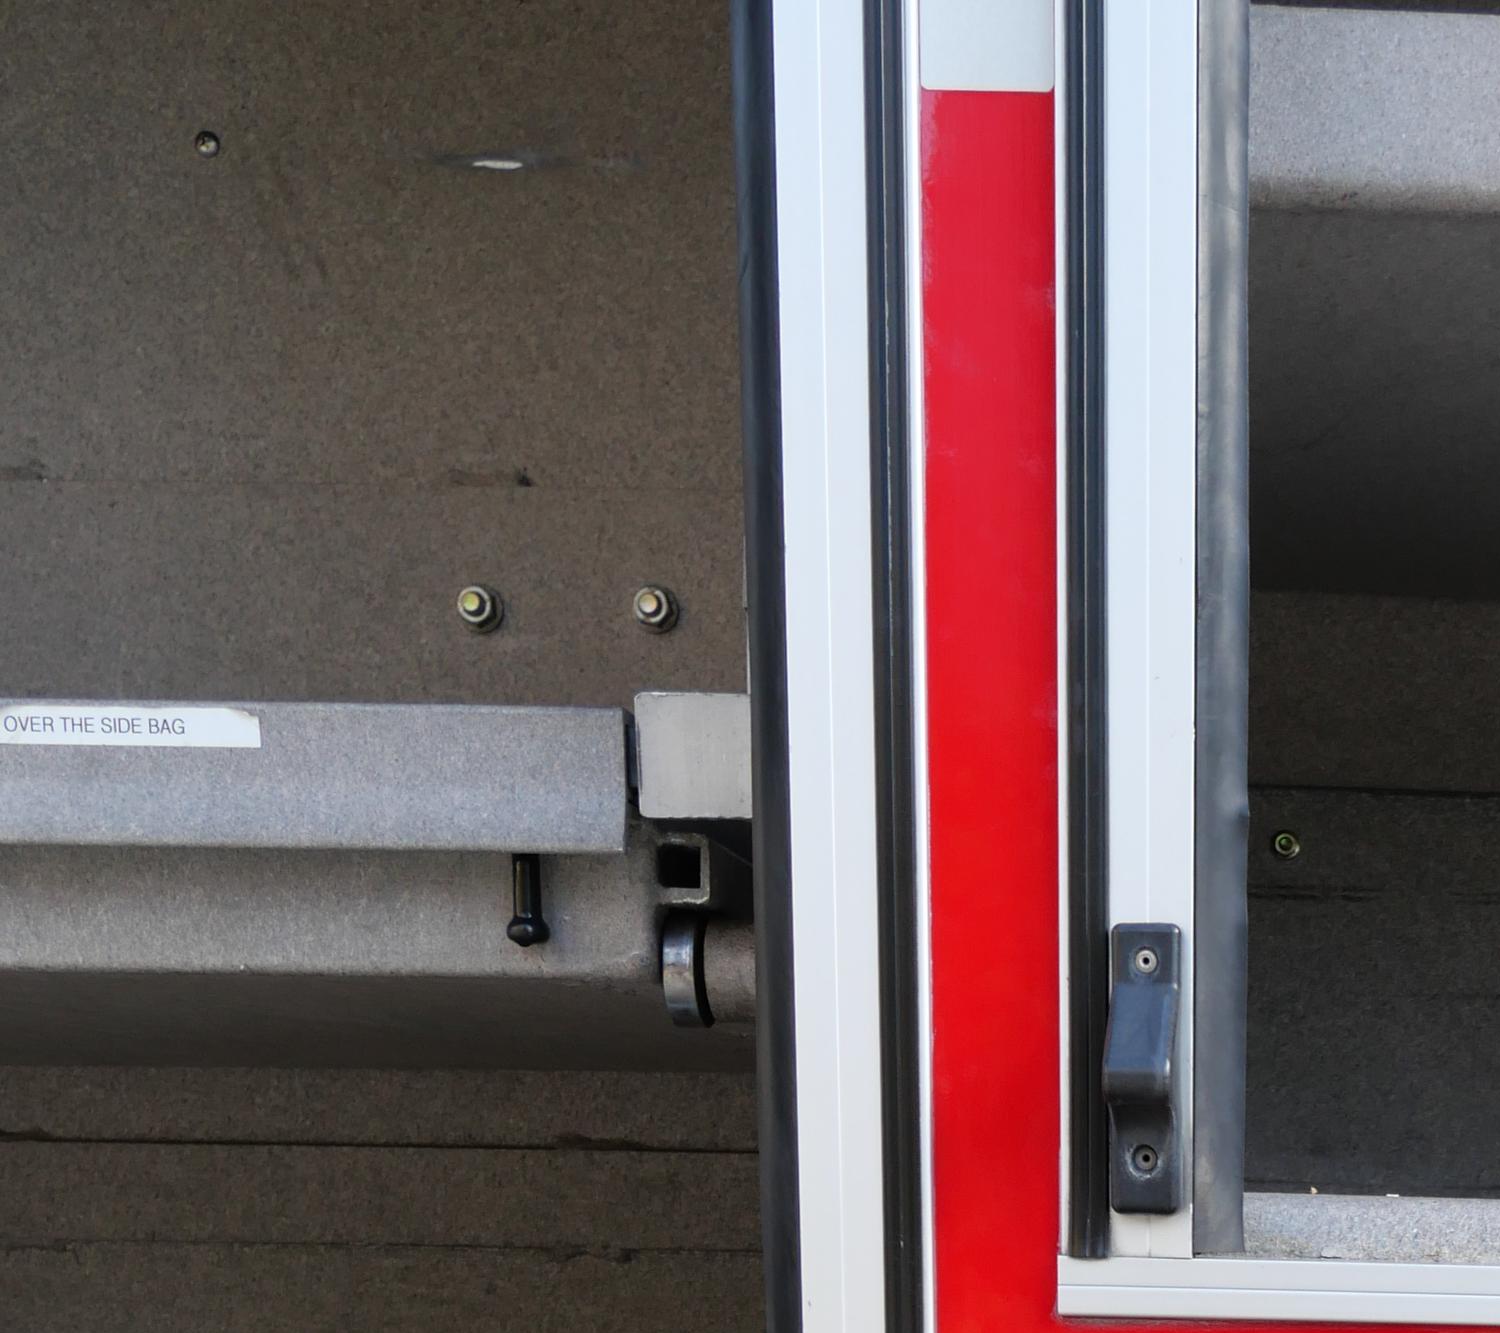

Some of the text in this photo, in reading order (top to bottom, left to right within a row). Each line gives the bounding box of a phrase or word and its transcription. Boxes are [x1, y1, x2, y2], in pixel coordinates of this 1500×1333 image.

[3, 715, 186, 735] OVER THE SIDE BAG
